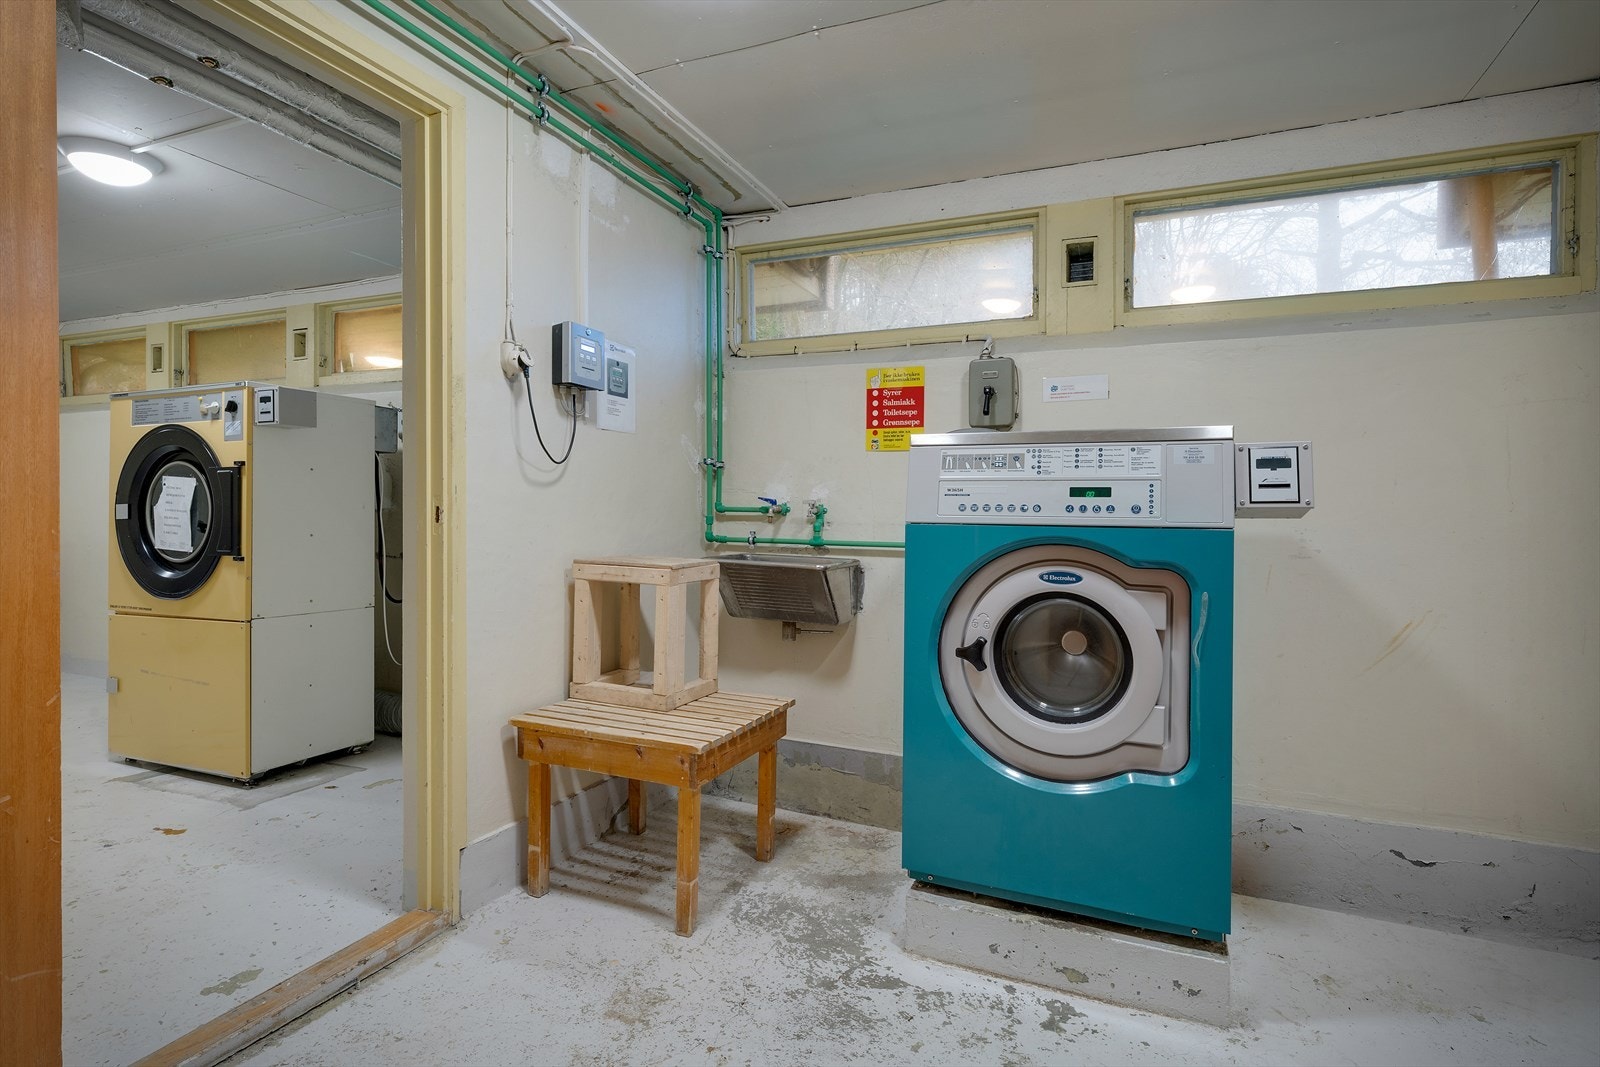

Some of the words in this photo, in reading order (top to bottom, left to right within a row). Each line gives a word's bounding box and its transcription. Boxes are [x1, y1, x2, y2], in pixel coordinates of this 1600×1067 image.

[883, 389, 902, 398] Syrer
[883, 398, 916, 406] Salmiakk
[883, 409, 918, 417] Toiletsepe
[883, 419, 921, 427] Grønnsepe
[1049, 574, 1076, 582] Electrolux
